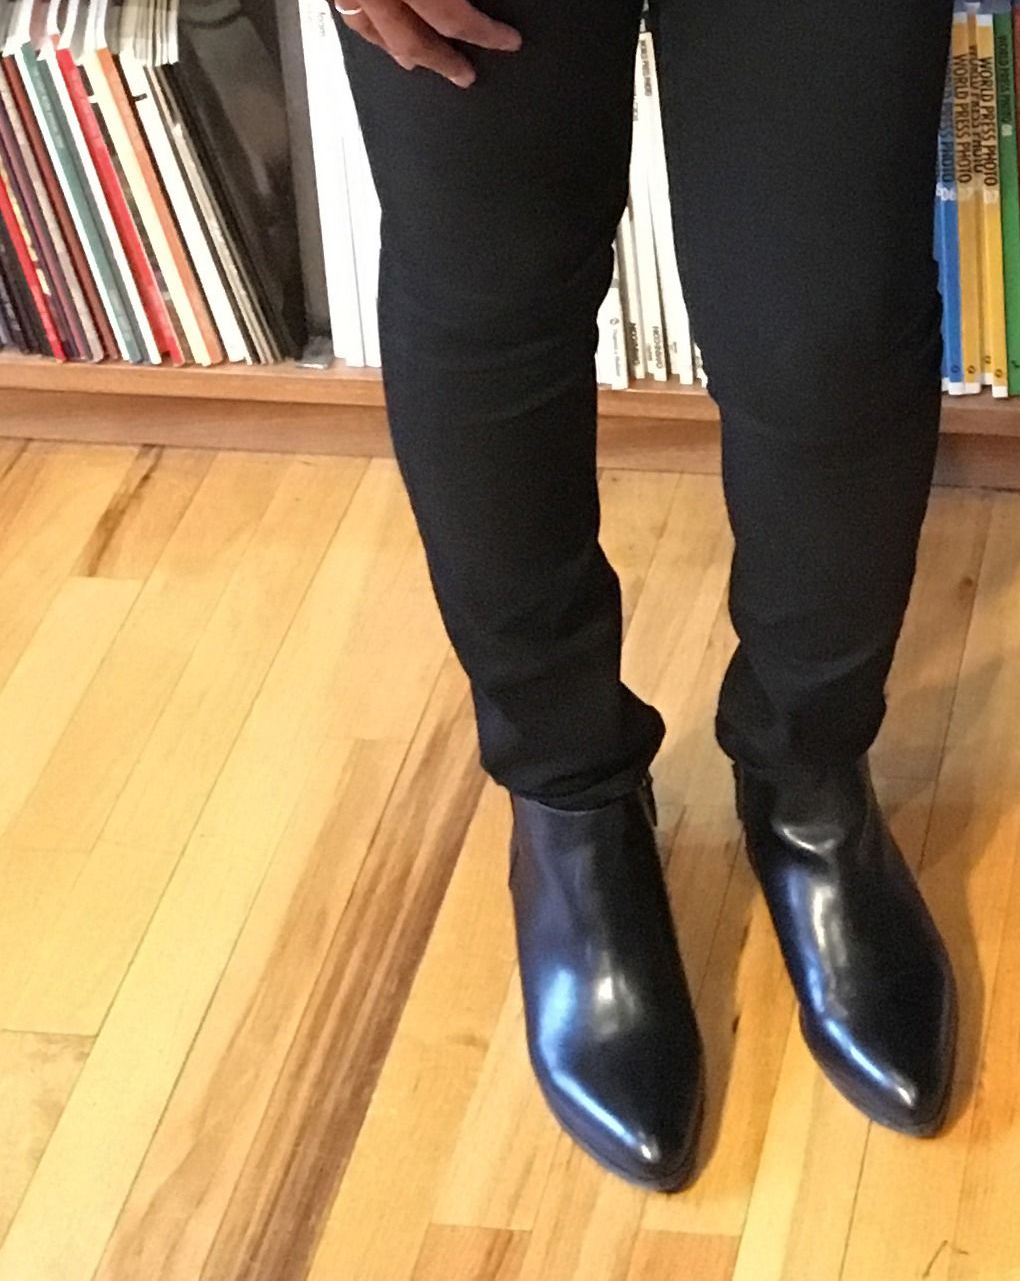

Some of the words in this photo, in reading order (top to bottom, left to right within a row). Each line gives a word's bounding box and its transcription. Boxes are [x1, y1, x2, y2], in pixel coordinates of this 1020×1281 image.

[952, 53, 969, 99] WORLD
[979, 56, 996, 102] WORLD
[954, 103, 971, 138] PRESS
[980, 105, 997, 142] PRESS
[956, 142, 972, 183] PHOTO
[982, 145, 998, 186] PHOTO
